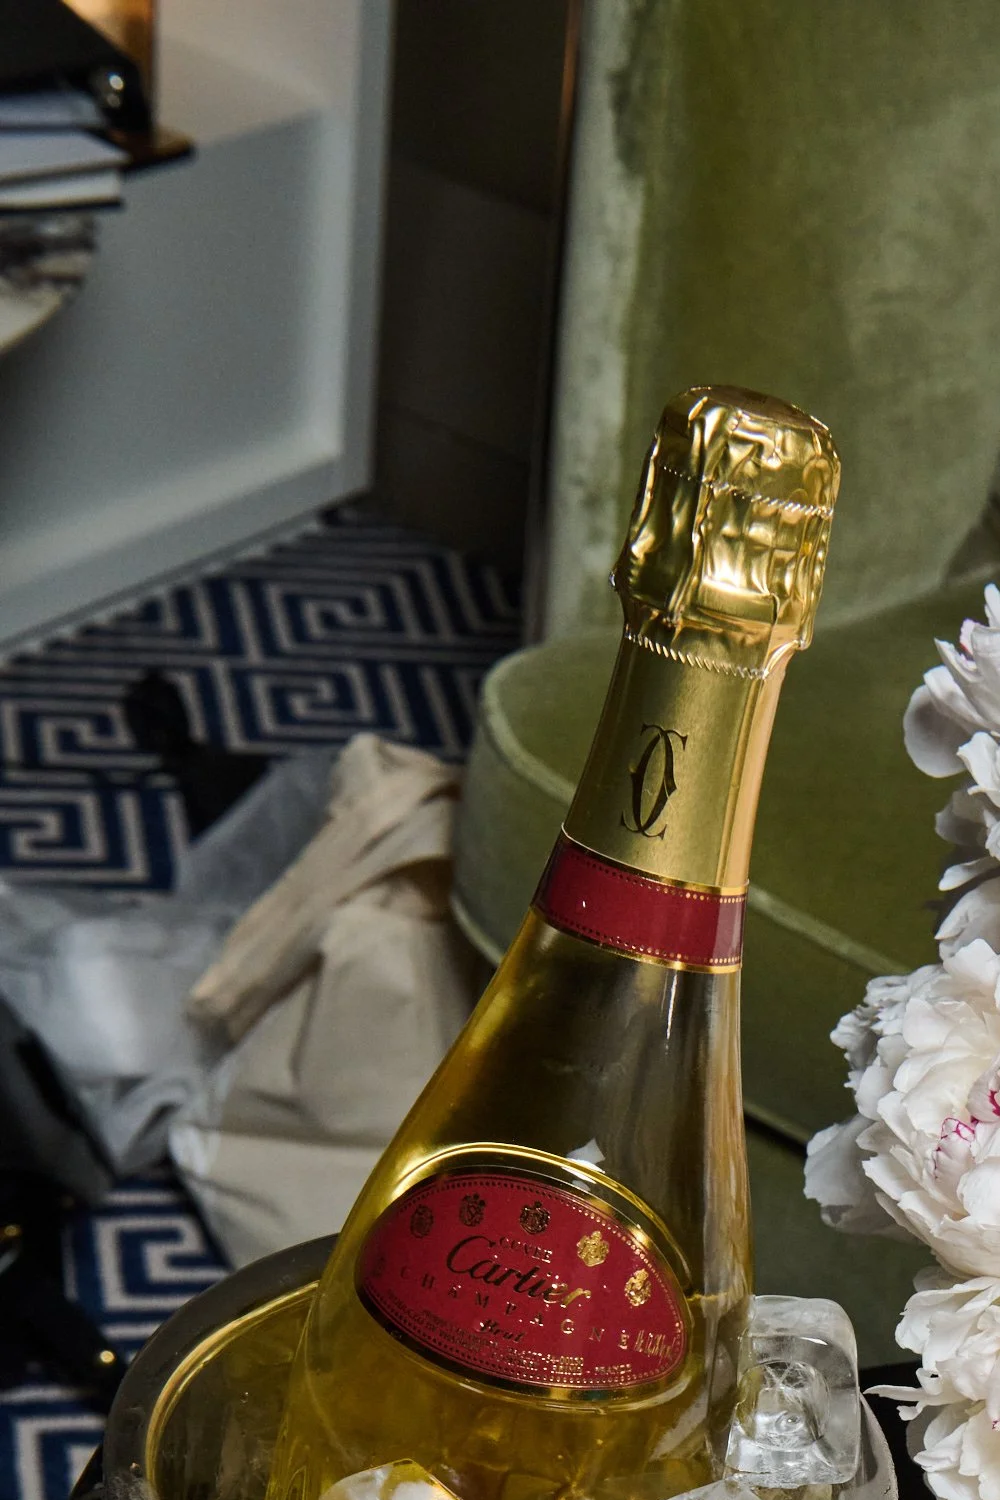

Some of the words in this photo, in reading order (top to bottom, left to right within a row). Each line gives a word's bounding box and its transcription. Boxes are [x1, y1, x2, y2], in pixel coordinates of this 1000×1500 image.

[400, 1265, 629, 1350] CHAMPAGNE
[446, 1235, 592, 1308] Cartier
[478, 1318, 526, 1343] Brut
